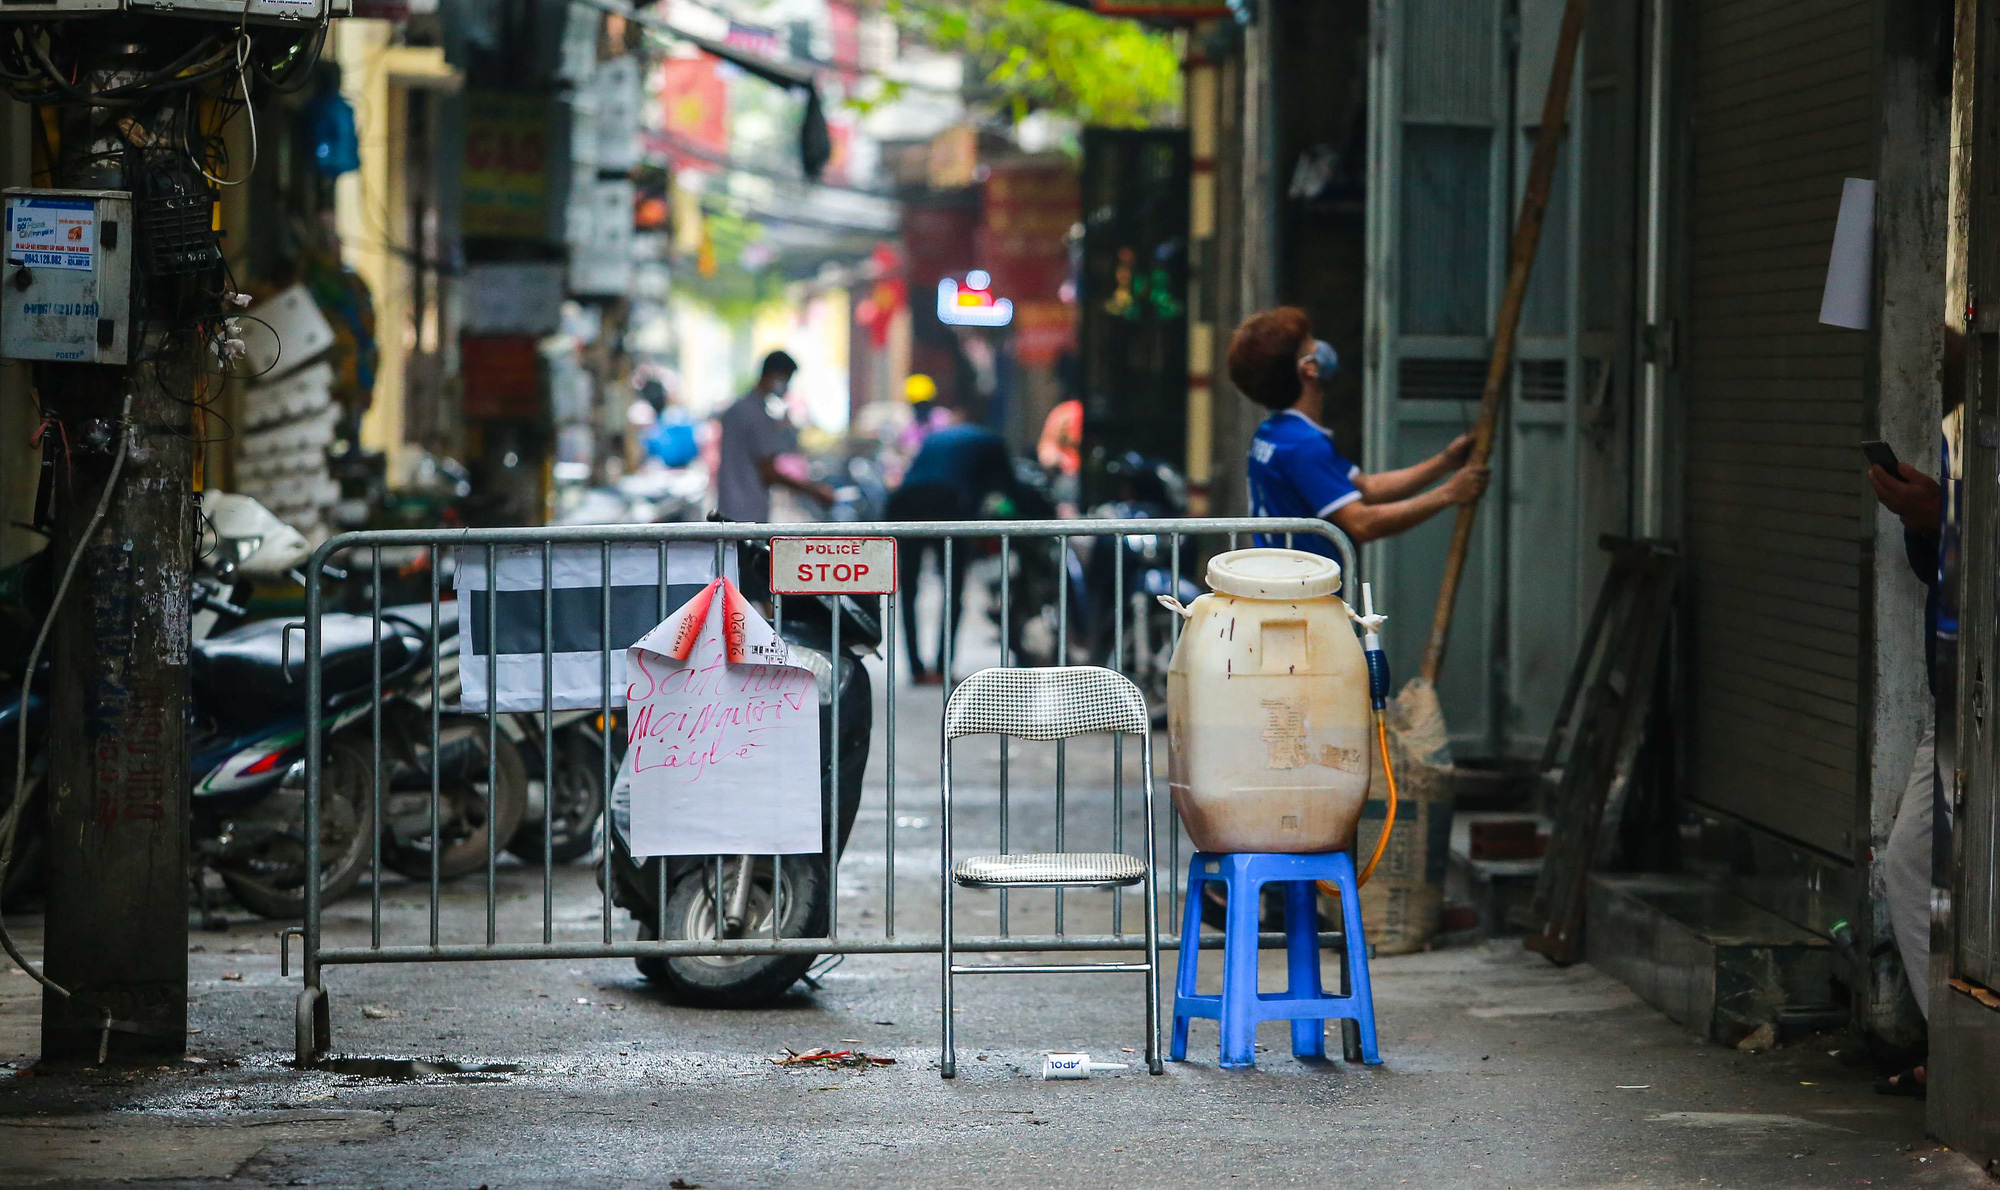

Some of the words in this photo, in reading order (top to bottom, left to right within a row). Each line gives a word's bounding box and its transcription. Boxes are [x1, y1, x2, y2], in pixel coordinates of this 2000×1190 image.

[805, 544, 860, 554] POLICE
[797, 563, 869, 582] STOP
[673, 617, 688, 653] VIETNAM
